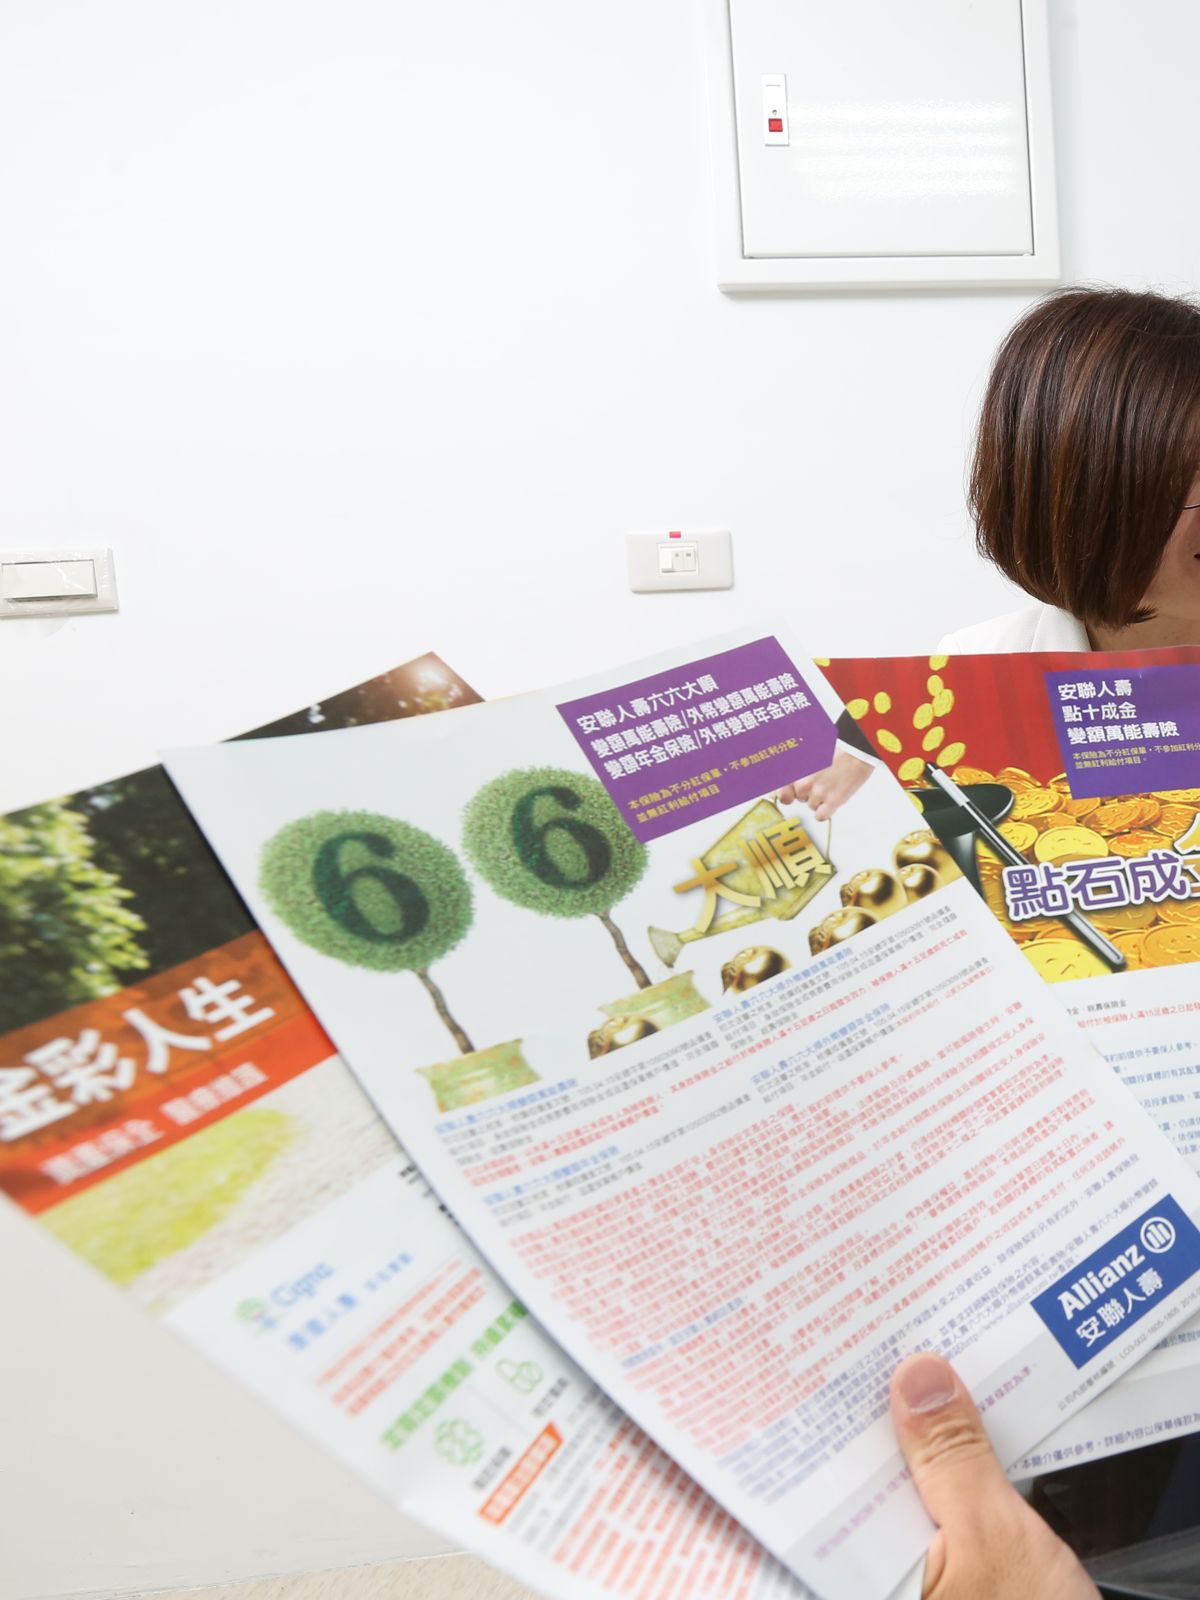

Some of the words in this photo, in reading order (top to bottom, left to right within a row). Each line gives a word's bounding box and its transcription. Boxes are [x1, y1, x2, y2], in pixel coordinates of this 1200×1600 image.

[577, 673, 719, 735] 安聯人壽六六大順
[591, 672, 800, 760] 變額萬能壽險/外幣變額萬能壽險
[1057, 679, 1132, 701] 安聯人壽
[1062, 701, 1137, 723] 點十成金
[604, 691, 812, 781] 變額年金保險/外幣變額年金保險
[1067, 720, 1180, 745] 變額萬能壽險
[512, 786, 612, 890] 6
[672, 817, 832, 933] 大順
[312, 831, 430, 943] 6
[0, 976, 277, 1143] 金彩人生
[1057, 1243, 1145, 1320] Allianz
[1076, 1267, 1164, 1348] 安聯人壽
